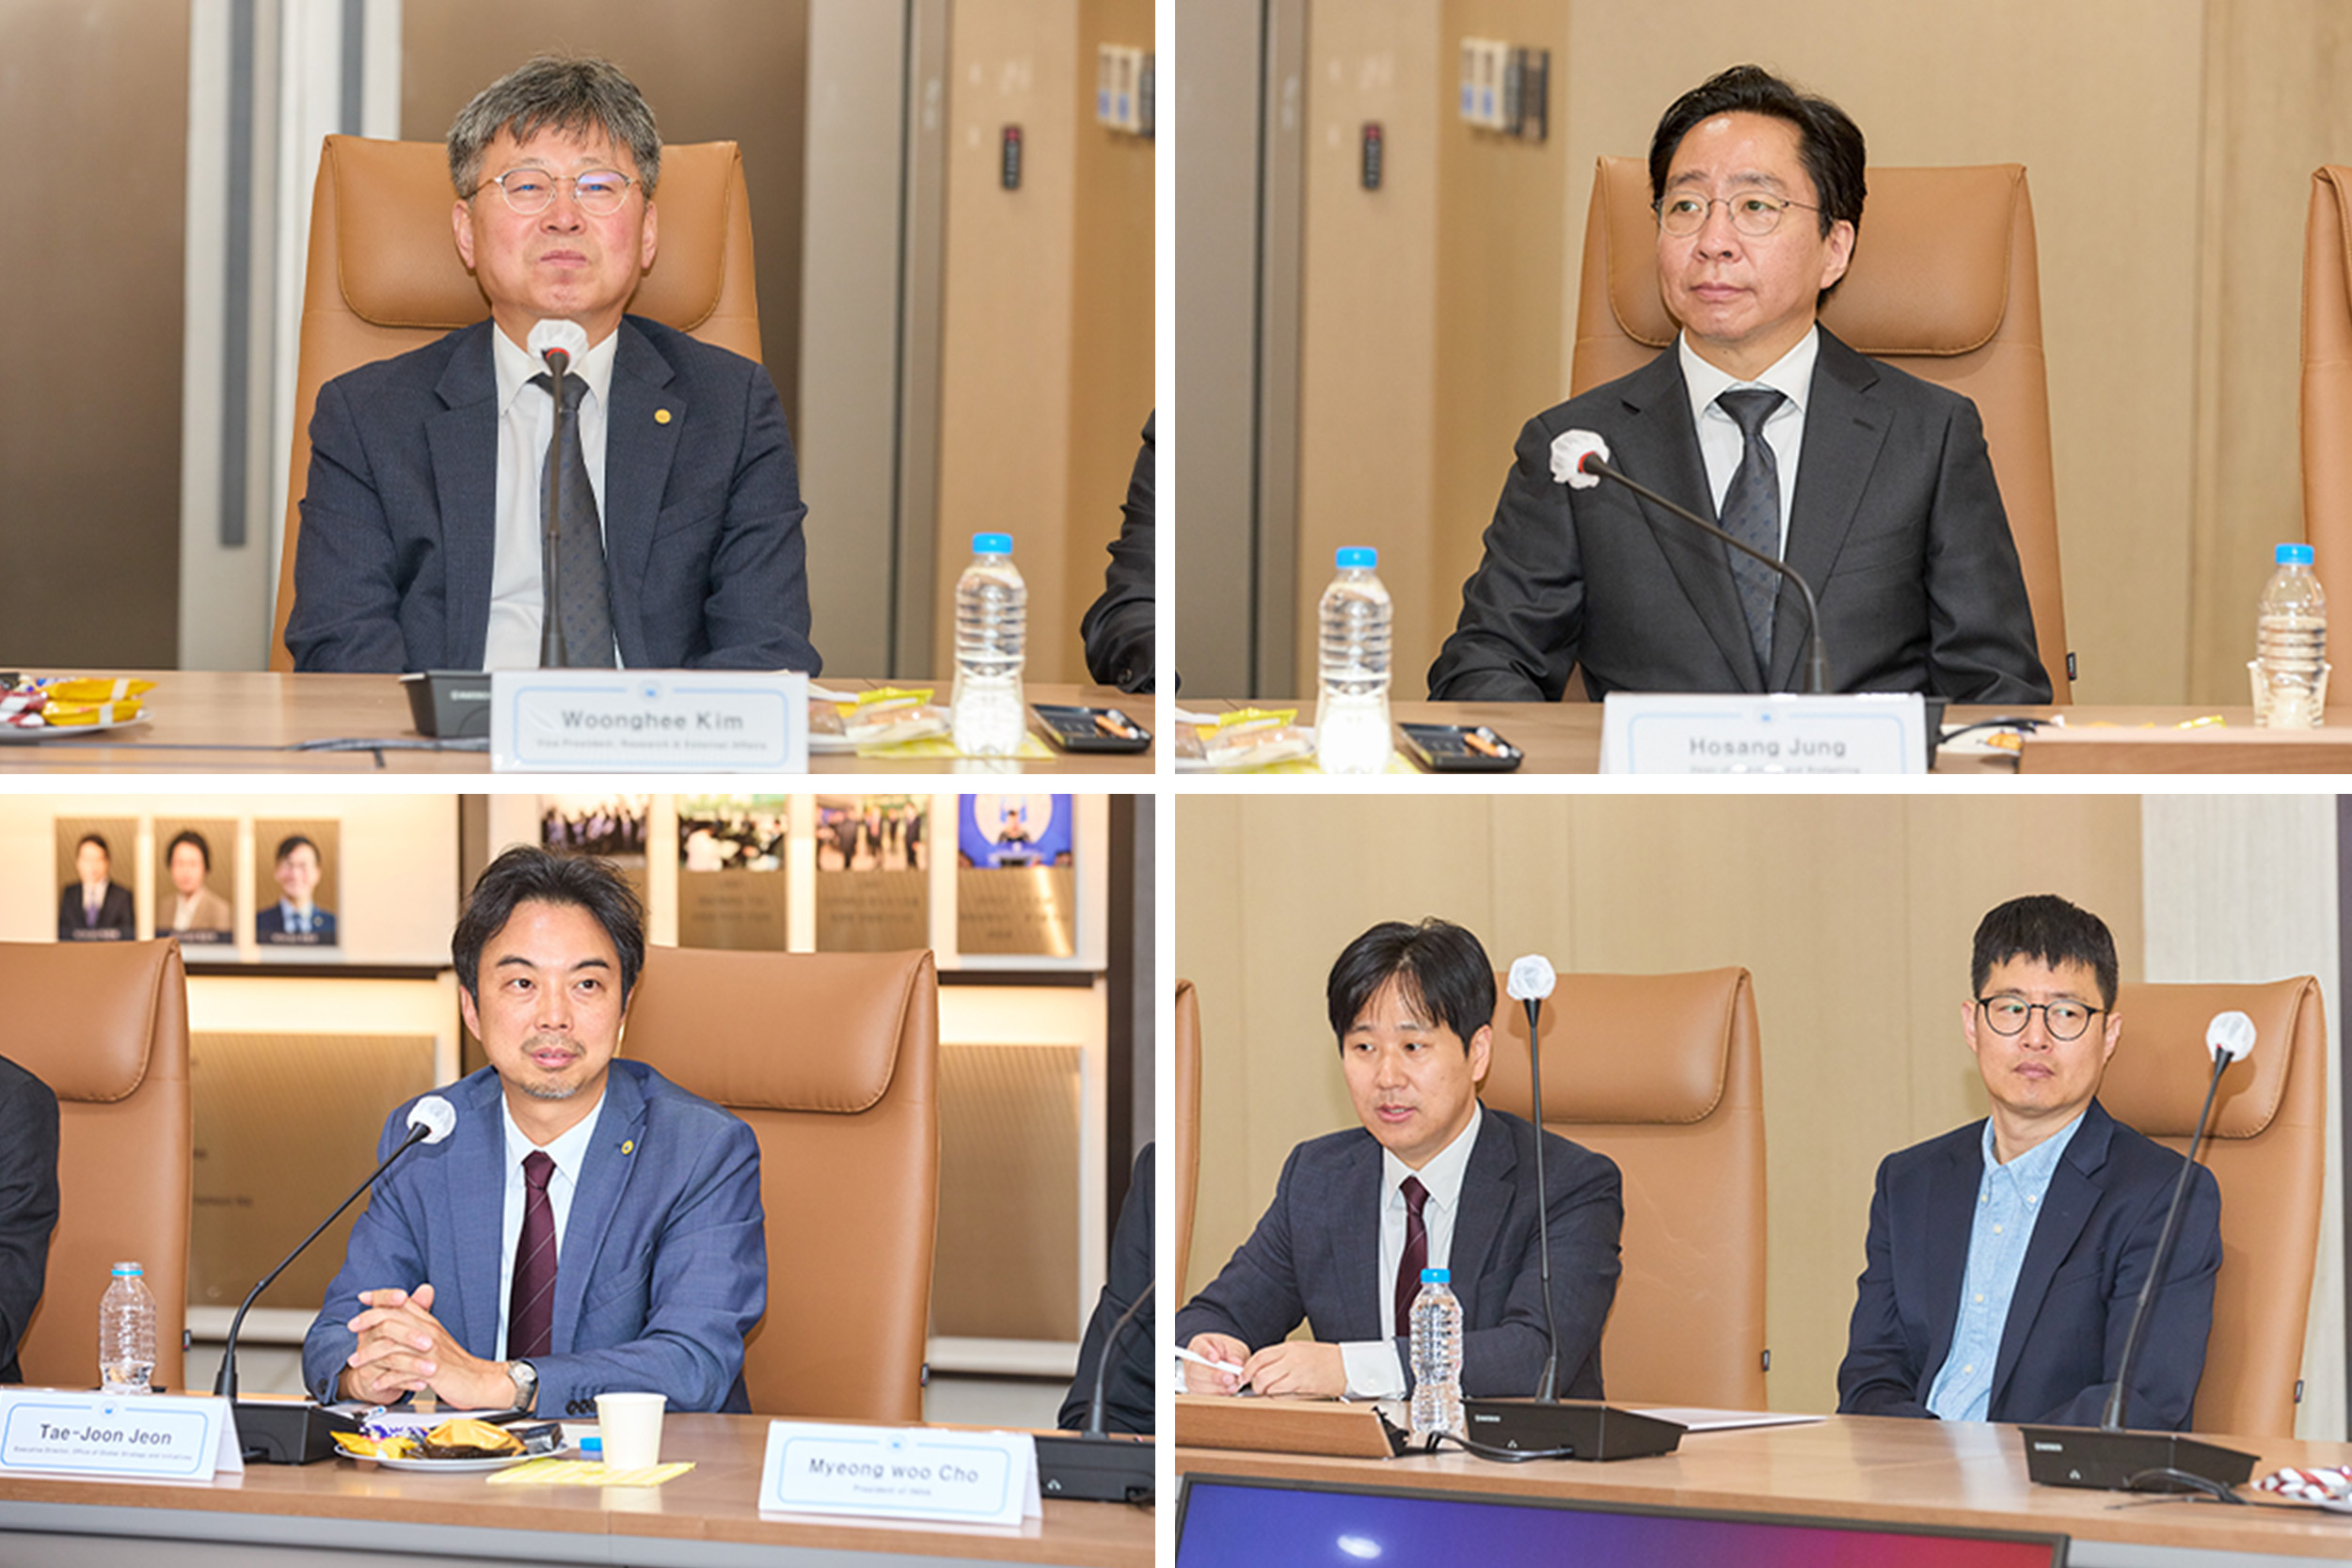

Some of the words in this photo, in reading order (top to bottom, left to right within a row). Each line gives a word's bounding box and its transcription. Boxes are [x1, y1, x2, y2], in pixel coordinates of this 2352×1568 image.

[561, 710, 687, 732] Woonghee
[696, 711, 743, 730] Kim
[1689, 737, 1781, 758] Hosang
[1788, 737, 1848, 758] Jung
[40, 1423, 124, 1443] Tae-Joon
[128, 1428, 173, 1446] Jeon
[808, 1458, 885, 1480] Myeong
[892, 1464, 932, 1481] woo
[939, 1465, 979, 1483] Cho
